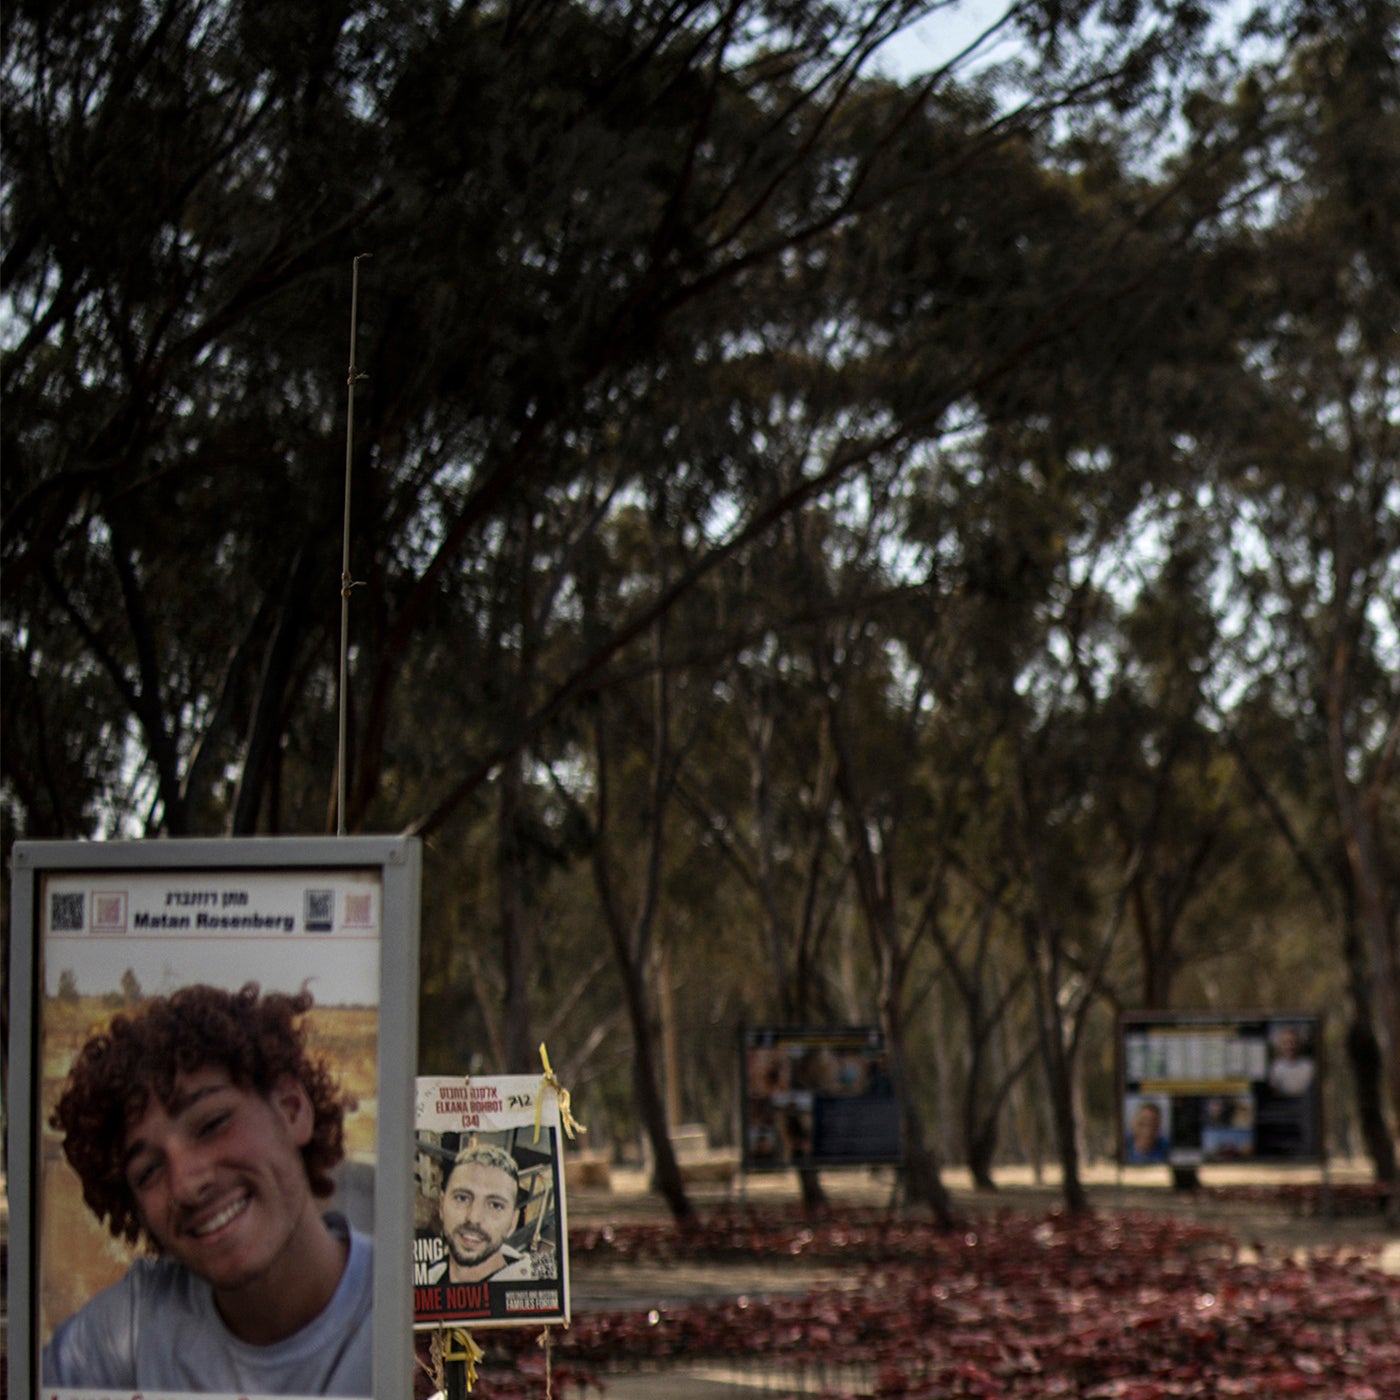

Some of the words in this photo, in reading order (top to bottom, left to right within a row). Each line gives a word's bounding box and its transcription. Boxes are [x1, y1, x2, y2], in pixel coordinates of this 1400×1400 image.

[134, 913, 190, 929] Matan
[196, 913, 295, 932] Rosenberg
[436, 1100, 468, 1113] ELKANA
[470, 1100, 503, 1113] BOHBOT
[446, 1282, 490, 1310] NOW!
